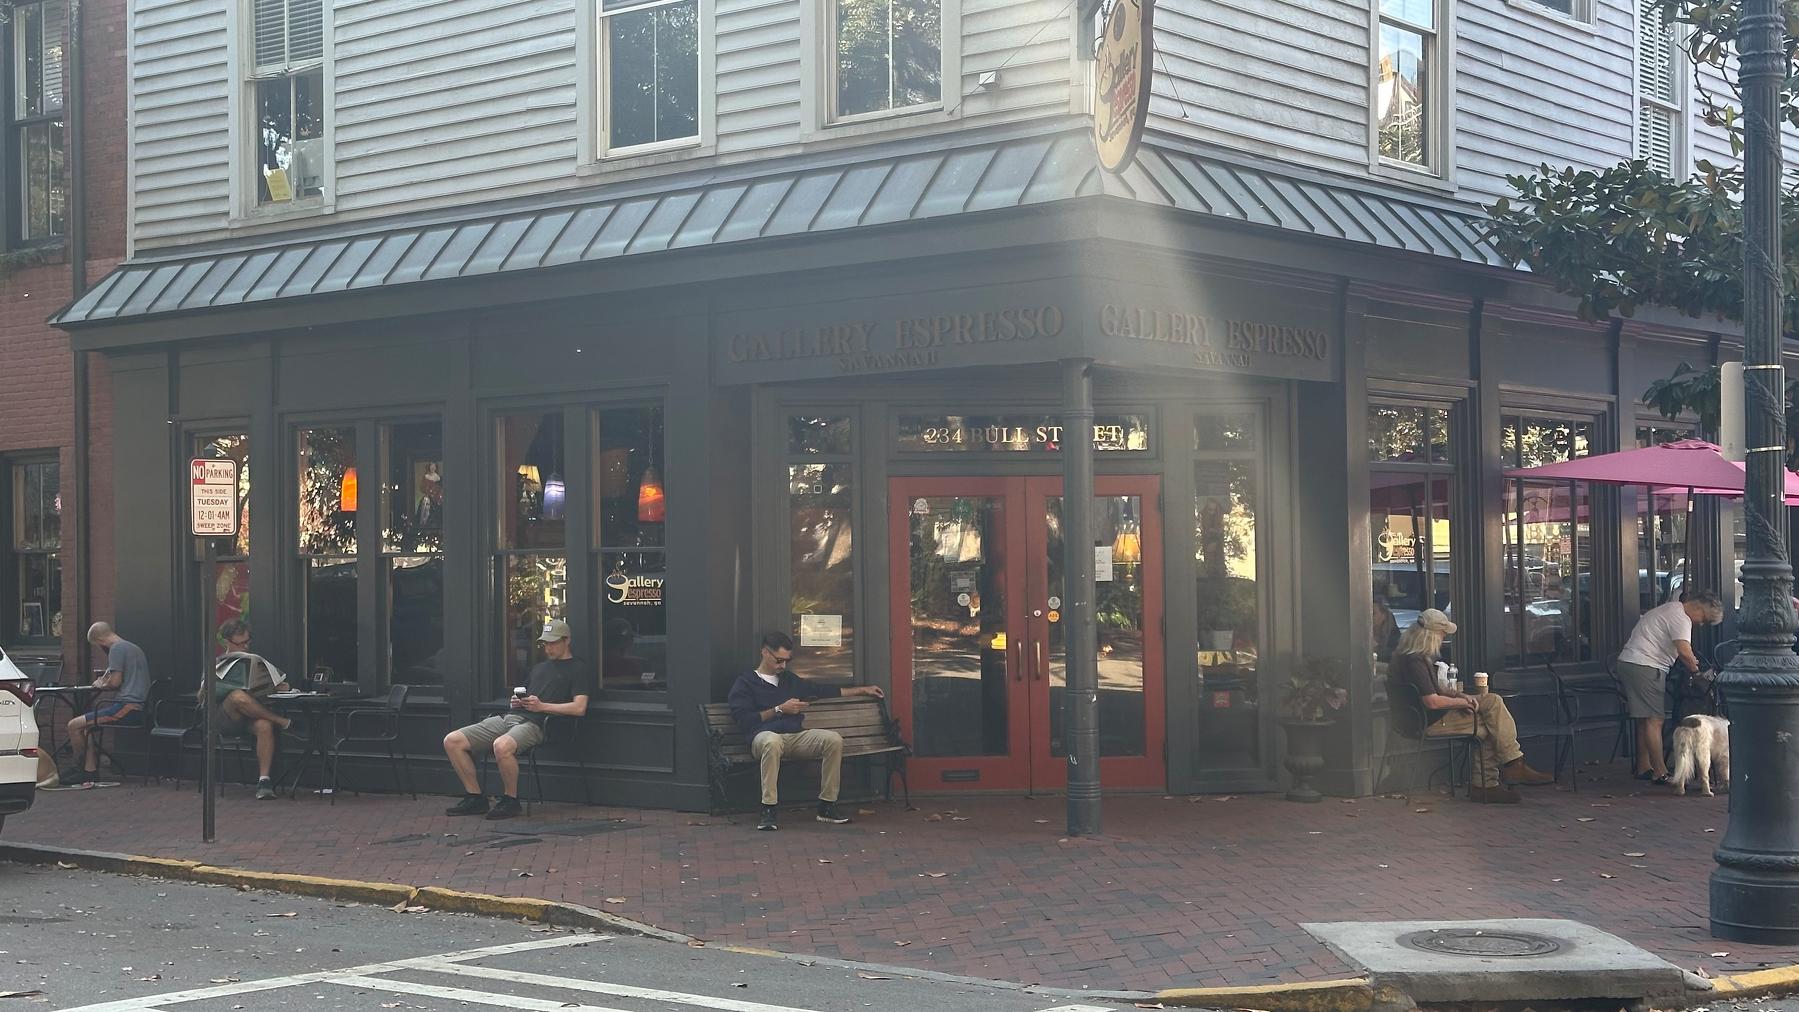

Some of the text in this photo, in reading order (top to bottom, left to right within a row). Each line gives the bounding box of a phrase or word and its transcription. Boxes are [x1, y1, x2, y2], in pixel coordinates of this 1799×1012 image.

[728, 304, 1065, 364] GALLERY ESPRESSO
[1100, 303, 1330, 361] GALLERY ESPRESSO
[838, 349, 939, 372] SAVANNAH
[924, 425, 1123, 444] 234 BULL STET
[193, 465, 233, 480] NO PARKING
[628, 588, 661, 600] espresso
